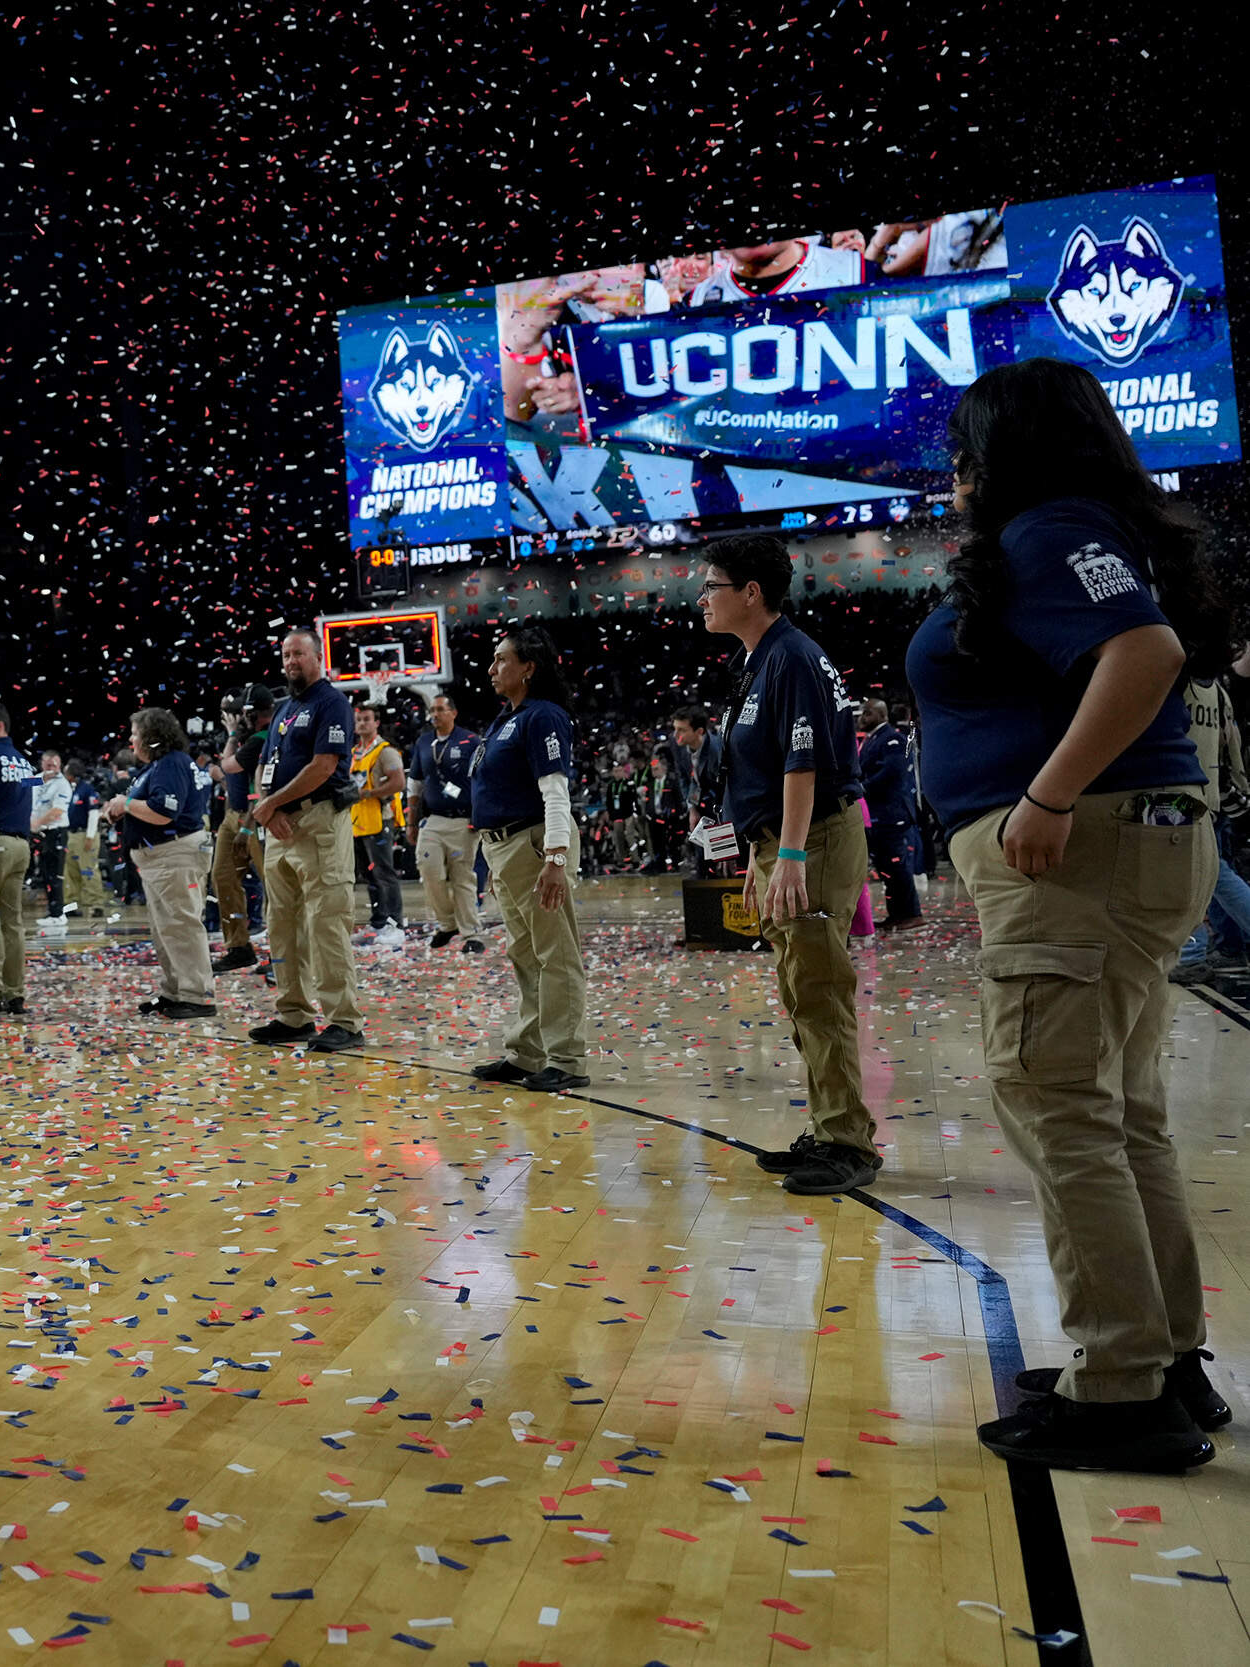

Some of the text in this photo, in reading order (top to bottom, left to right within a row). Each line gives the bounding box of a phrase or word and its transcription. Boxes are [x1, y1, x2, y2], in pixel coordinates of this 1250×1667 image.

[619, 308, 978, 397] UCONN
[1100, 371, 1196, 408] IONAL
[694, 409, 839, 430] #UConnNation
[1115, 399, 1219, 436] PIONS
[371, 456, 481, 493] NATIONAL
[842, 504, 873, 524] 75
[649, 523, 676, 542] 60
[1091, 583, 1139, 603] SECURITY
